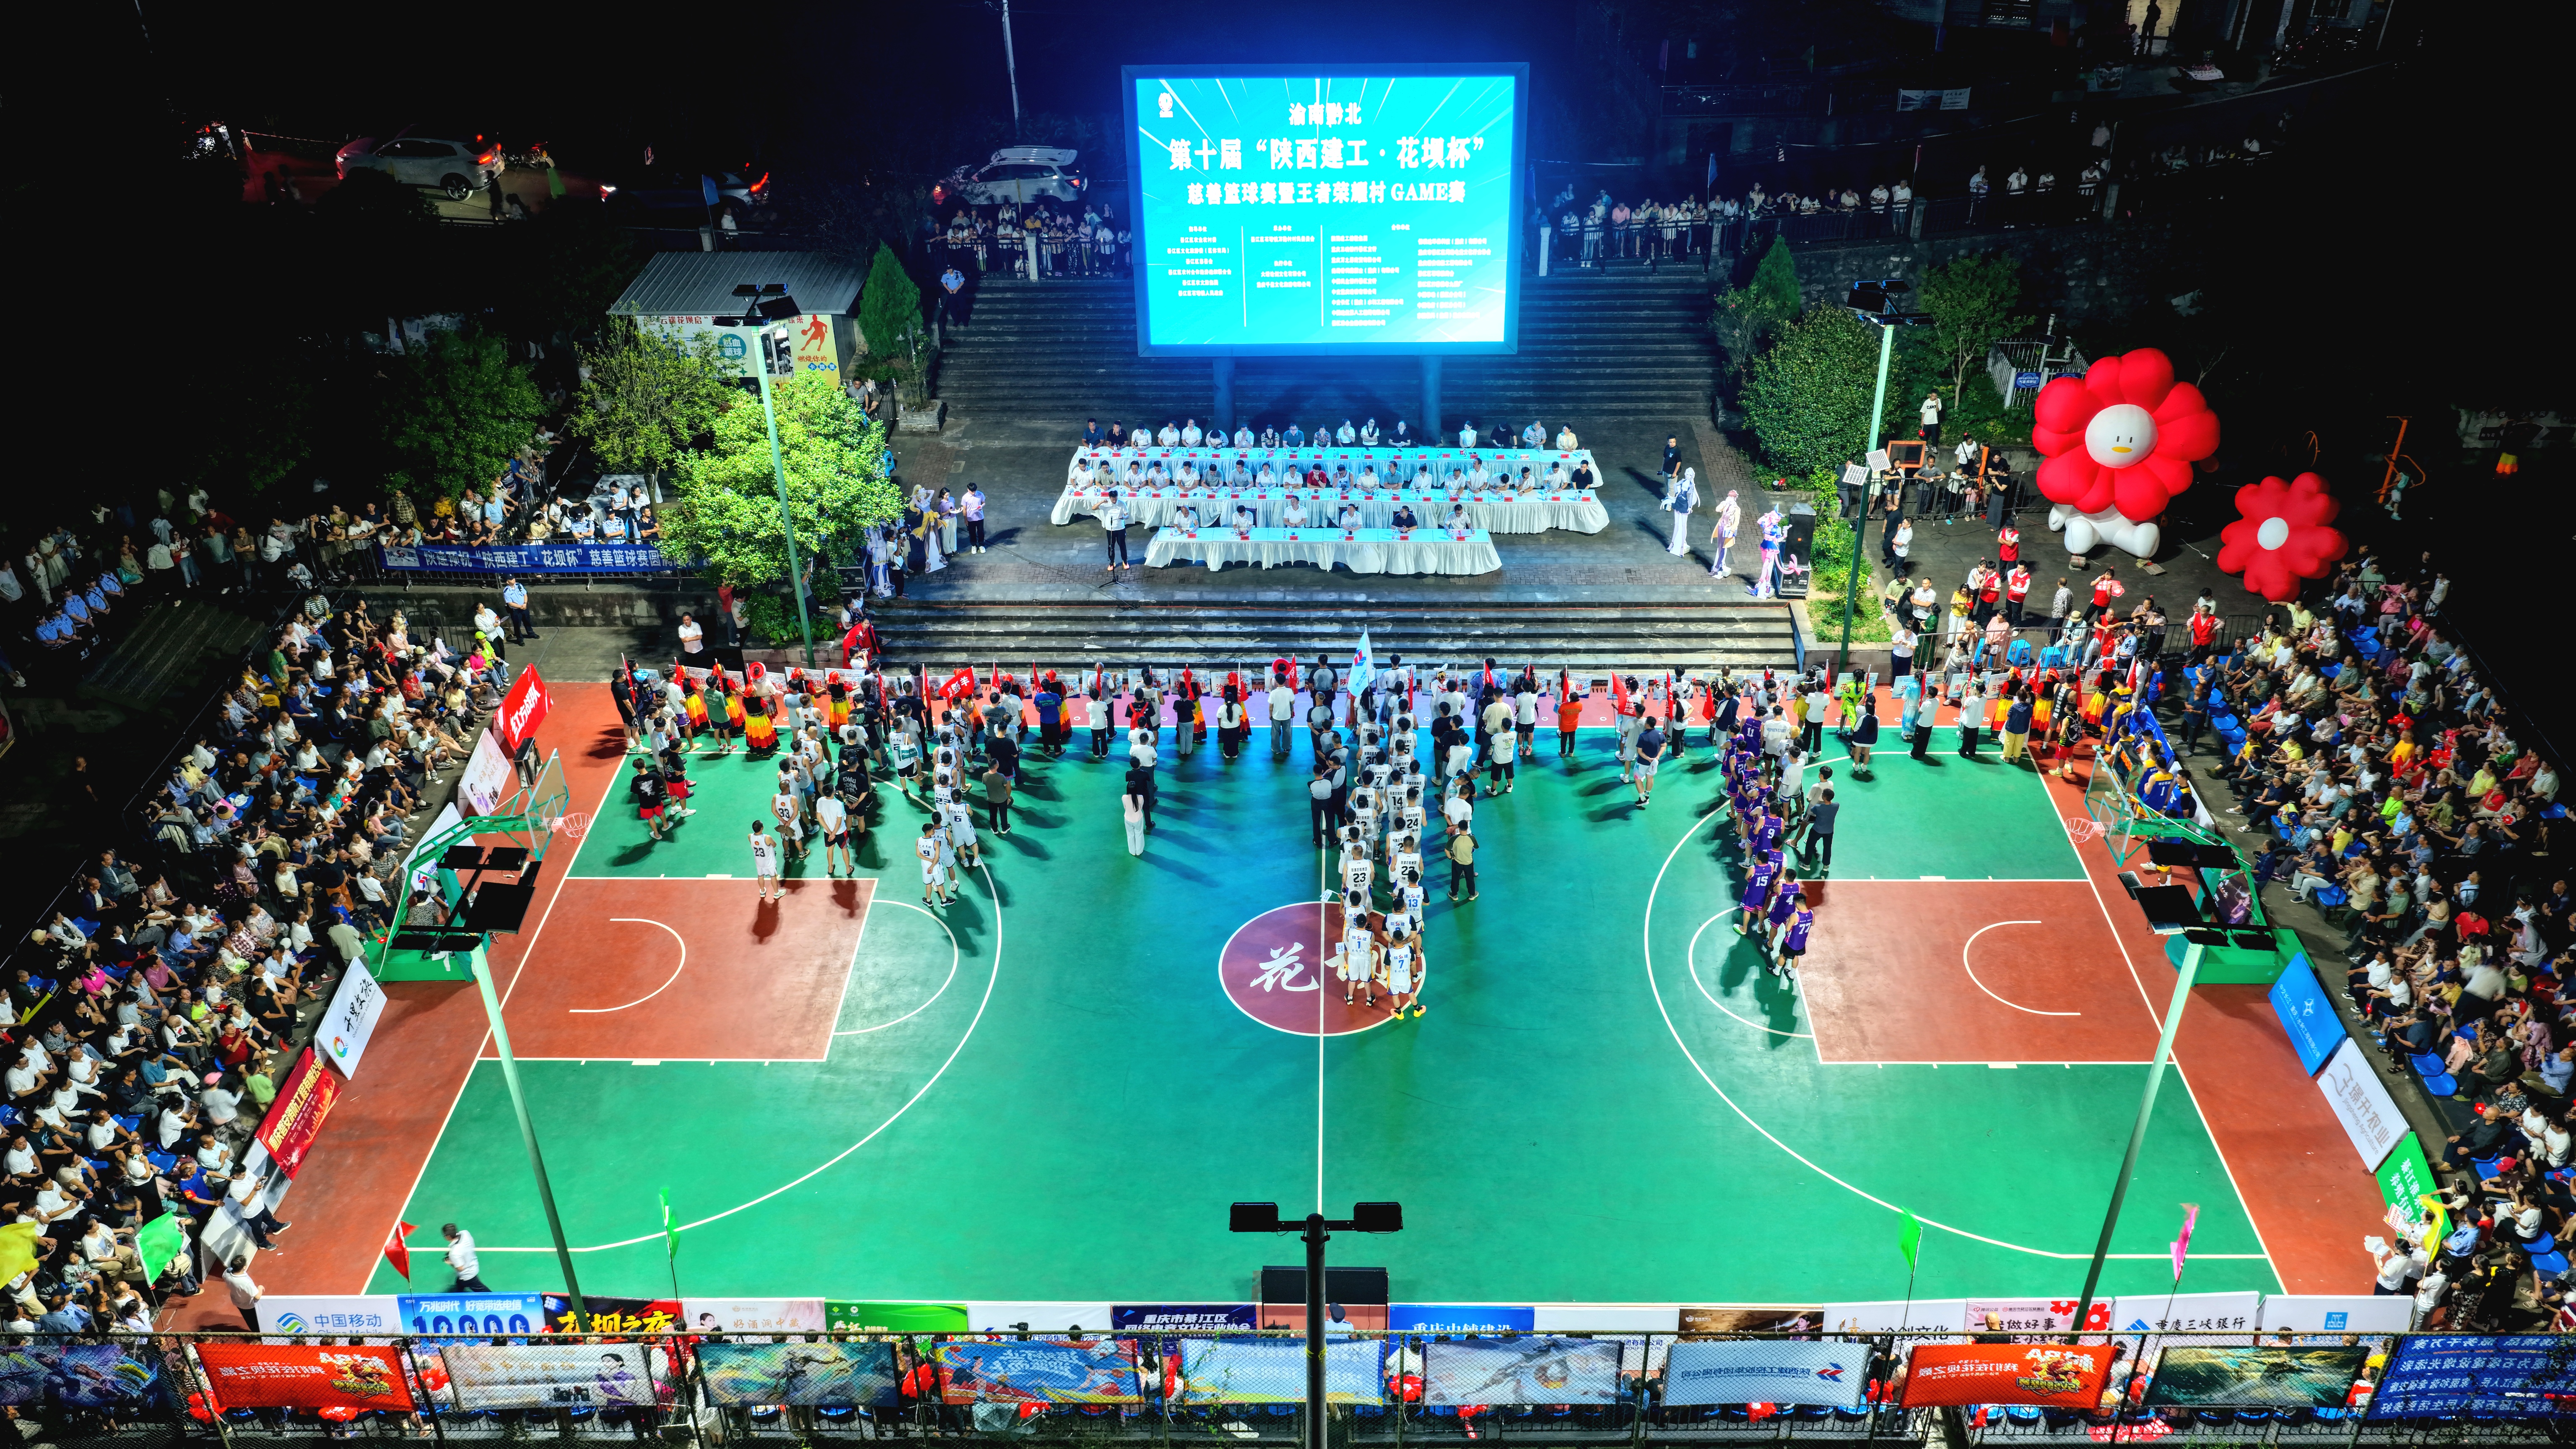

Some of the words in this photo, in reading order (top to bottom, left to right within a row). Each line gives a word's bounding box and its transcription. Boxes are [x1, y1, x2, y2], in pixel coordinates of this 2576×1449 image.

[1289, 102, 1362, 127] 渝南黔北
[1169, 138, 1242, 171] 第十届
[1187, 182, 1386, 205] 慈善篮球赛暨王者荣耀村
[1391, 180, 1466, 203] GAME赛
[424, 550, 473, 567] 陕建预祝
[510, 680, 541, 743] 红方战队
[1747, 727, 1754, 737] 11
[1376, 776, 1383, 786] 7
[2160, 786, 2165, 796] 1
[1392, 796, 1403, 806] 14
[778, 808, 790, 819] 33
[1407, 818, 1418, 828] 24
[1767, 828, 1775, 839] 9
[753, 847, 766, 857] 23
[1353, 873, 1366, 883] 23
[1756, 876, 1768, 887] 15
[1408, 898, 1418, 907] 13
[1799, 923, 1811, 935] 77
[1357, 941, 1361, 949] 1
[1398, 959, 1404, 969] 7
[368, 989, 377, 1005] Tourism
[2359, 1124, 2379, 1155] Agriculture
[420, 1300, 460, 1312] 万兆时代
[465, 1299, 522, 1312] 好宽带选电信
[314, 1314, 382, 1328] 中国移动
[733, 1317, 802, 1330] 好酒洞中藏
[1143, 1313, 1229, 1324] 重庆市綦江区
